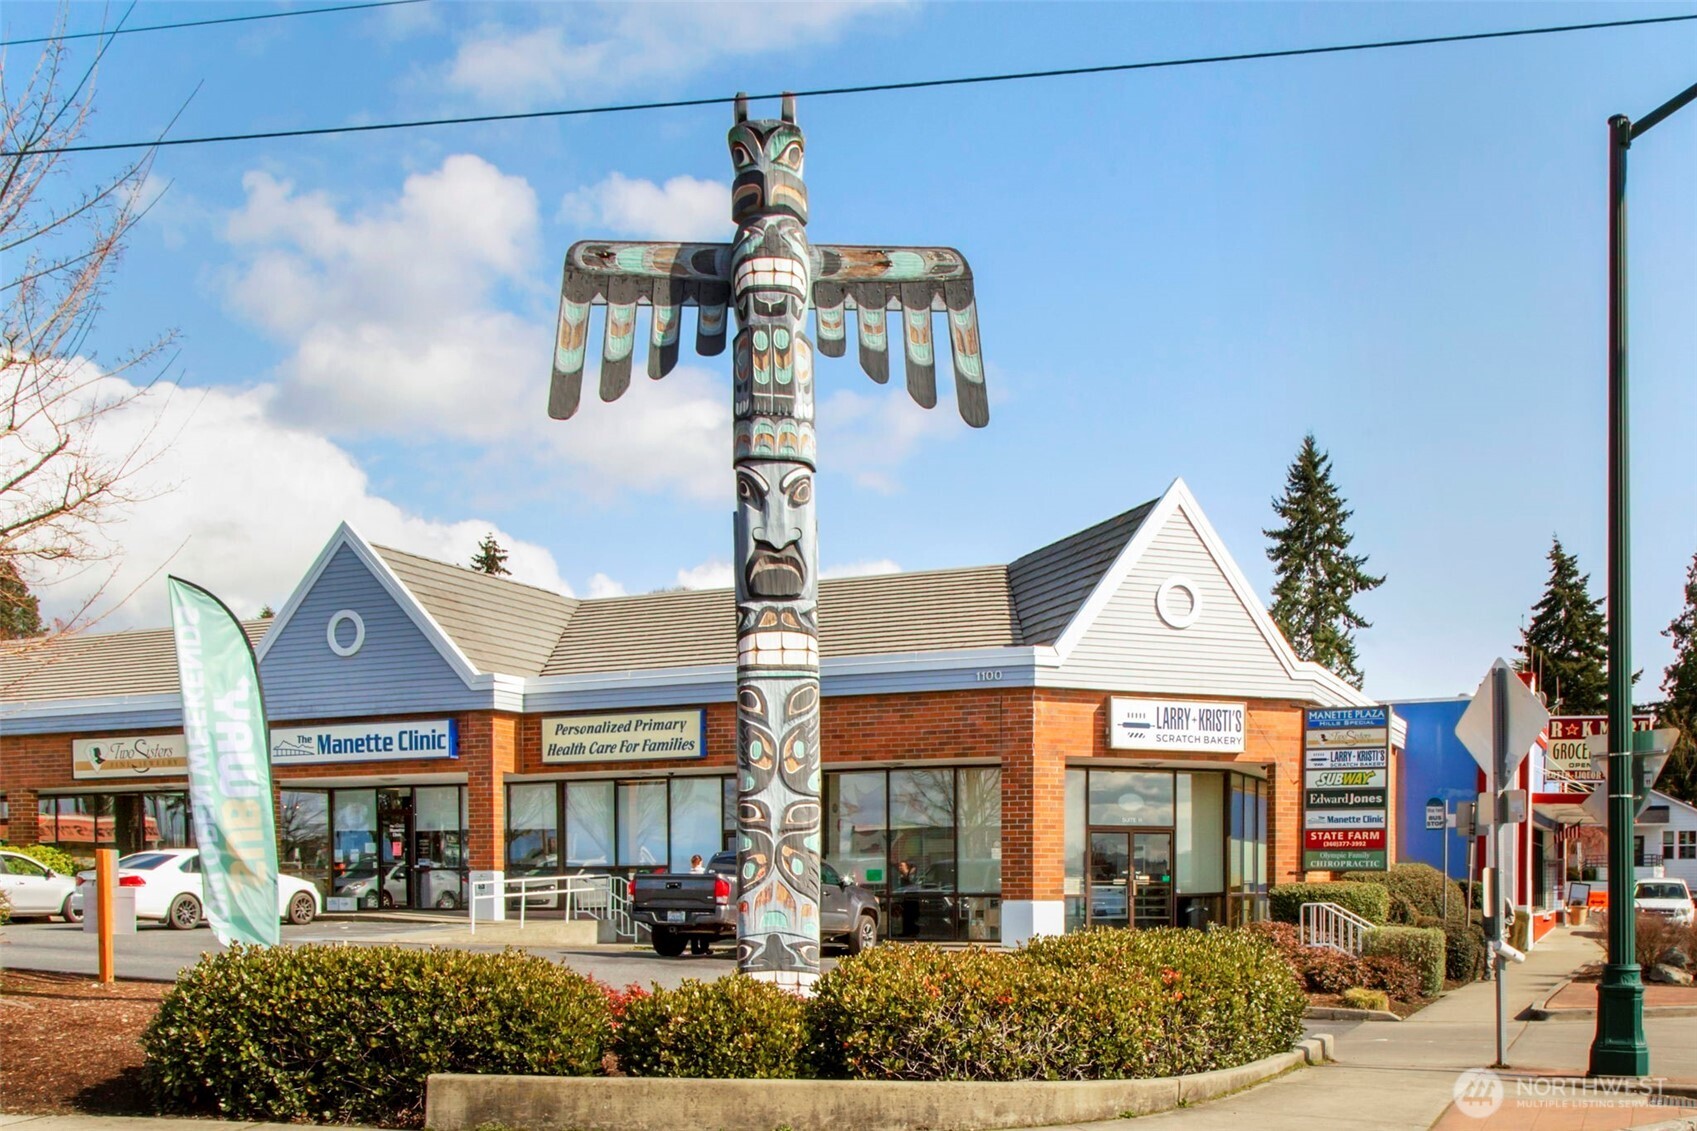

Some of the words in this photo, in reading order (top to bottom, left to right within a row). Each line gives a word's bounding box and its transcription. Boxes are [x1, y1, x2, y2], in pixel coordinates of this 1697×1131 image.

[976, 670, 1002, 681] 1100
[1156, 706, 1191, 731] LARRY
[1198, 708, 1242, 732] KRISTI'S
[1309, 710, 1353, 719] MANETTE
[1355, 709, 1384, 718] PLAZA
[555, 720, 632, 736] Personalized
[634, 718, 687, 733] Primary
[297, 735, 312, 744] The
[317, 733, 393, 755] Manette
[398, 729, 446, 751] Clinic
[1156, 734, 1200, 744] SCRATCH
[1204, 735, 1242, 745] BAKERY
[547, 742, 587, 757] Health
[588, 741, 617, 755] Care
[619, 739, 640, 753] For
[641, 737, 695, 752] Families
[1553, 742, 1591, 760] GROCE
[110, 742, 135, 759] Two
[134, 739, 173, 773] Sisters
[1330, 751, 1352, 762] LARRY
[1357, 750, 1385, 761] KRISTI'S
[1315, 770, 1376, 787] SUBWAY
[1309, 793, 1348, 804] Edward
[1348, 793, 1382, 805] Jones
[1327, 815, 1361, 823] Manette
[1363, 815, 1383, 823] Clinic
[1310, 832, 1344, 840] STATE
[1348, 831, 1380, 840] FARM
[1320, 851, 1345, 859] Olympic
[1348, 851, 1370, 859] Family
[1310, 859, 1380, 868] CHIROPRACTIC
